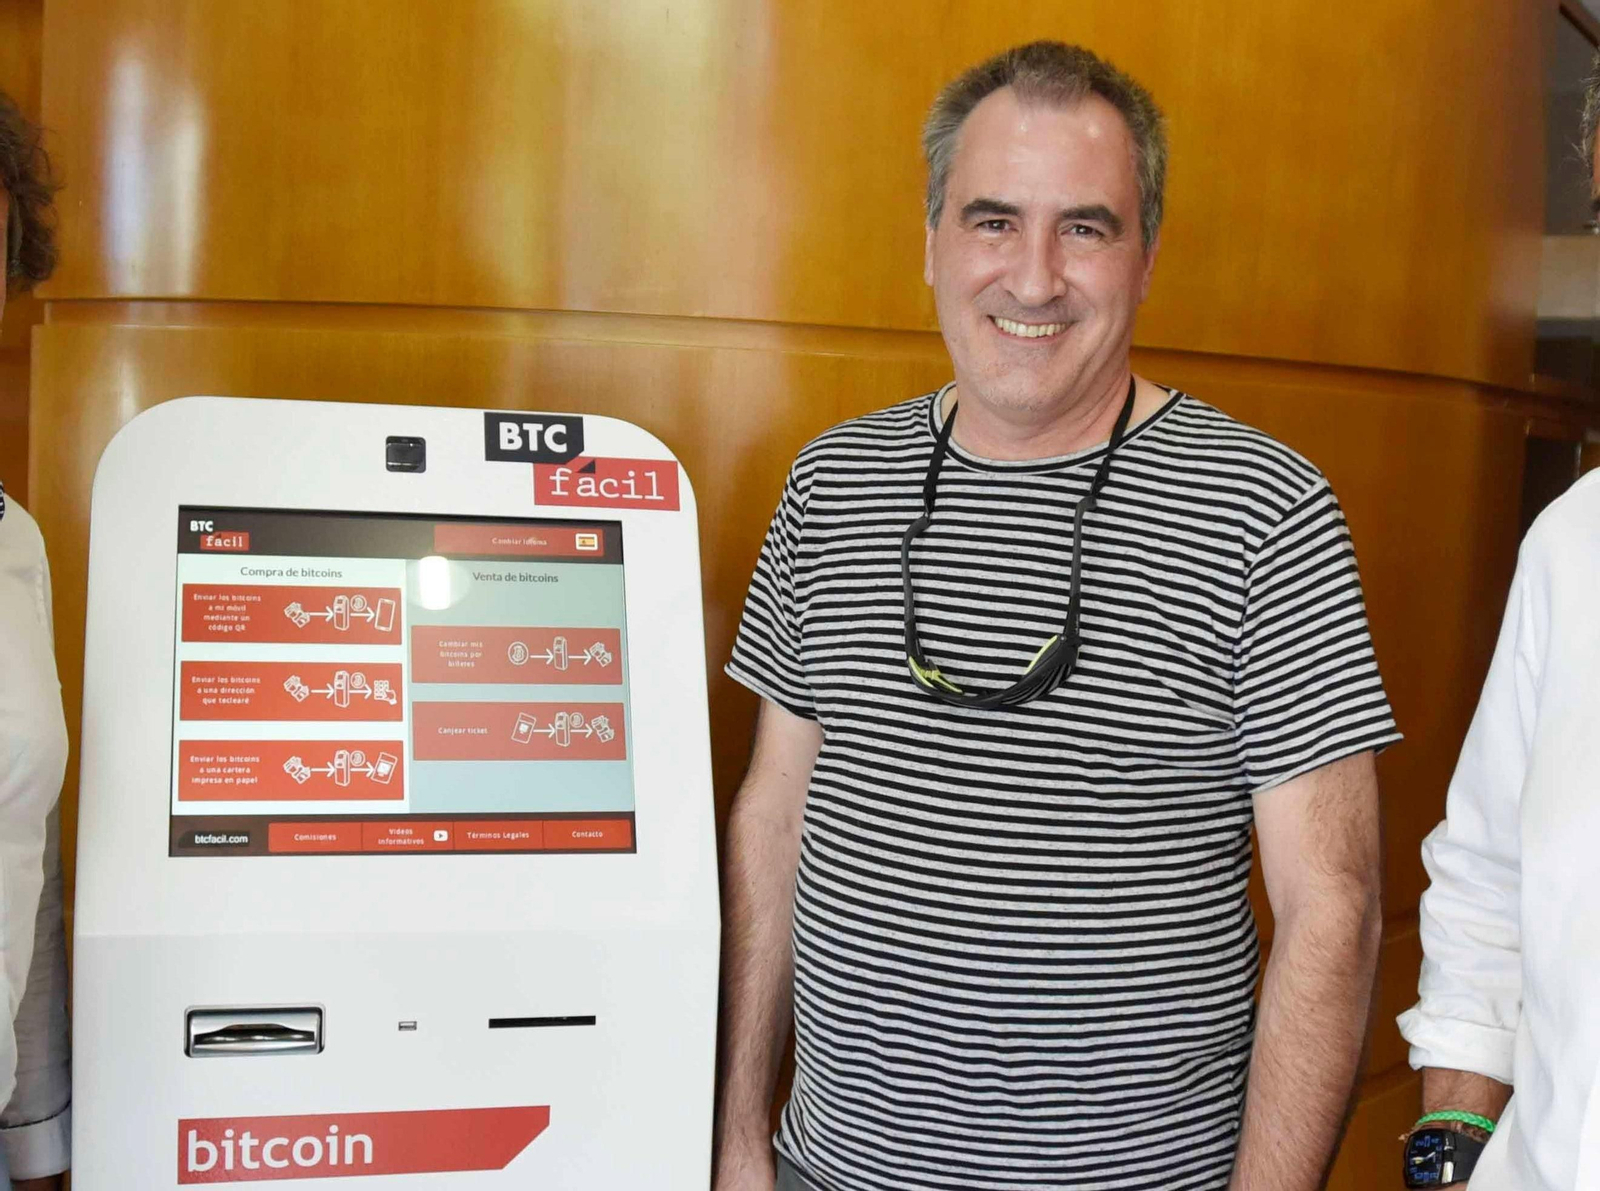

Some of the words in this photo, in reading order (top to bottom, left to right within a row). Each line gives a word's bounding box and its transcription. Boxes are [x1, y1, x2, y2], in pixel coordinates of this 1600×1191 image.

[499, 422, 568, 453] BTC
[190, 520, 214, 532] BTC
[491, 537, 521, 545] Cambiar
[240, 566, 284, 579] Compra
[286, 567, 299, 577] de
[301, 568, 343, 578] bitcoins
[472, 571, 503, 582] Venta
[504, 572, 517, 582] de
[519, 573, 559, 583] bitcoins
[193, 593, 217, 601] Enviar
[219, 593, 230, 602] los
[232, 594, 262, 602] bitcoins
[208, 624, 233, 632] código
[235, 624, 246, 632] QR
[438, 640, 468, 648] Cambiar
[191, 676, 216, 684] Enviar
[217, 676, 229, 684] los
[230, 676, 261, 684] bitcoins
[220, 686, 255, 694] dirección
[202, 697, 217, 705] que
[438, 727, 466, 735] Canjear
[467, 727, 488, 735] ticket
[190, 755, 214, 763] Enviar
[216, 755, 228, 763] los
[229, 755, 260, 763] bitcoins
[223, 766, 251, 774] cartera
[191, 777, 222, 785] impresa
[236, 776, 258, 785] papel
[293, 833, 337, 842] Comisiones
[467, 831, 501, 840] Términos
[503, 831, 530, 840] Legales
[571, 830, 603, 838] Contacto
[194, 834, 249, 845] btcfacil.com
[187, 1124, 374, 1172] bitcoin
